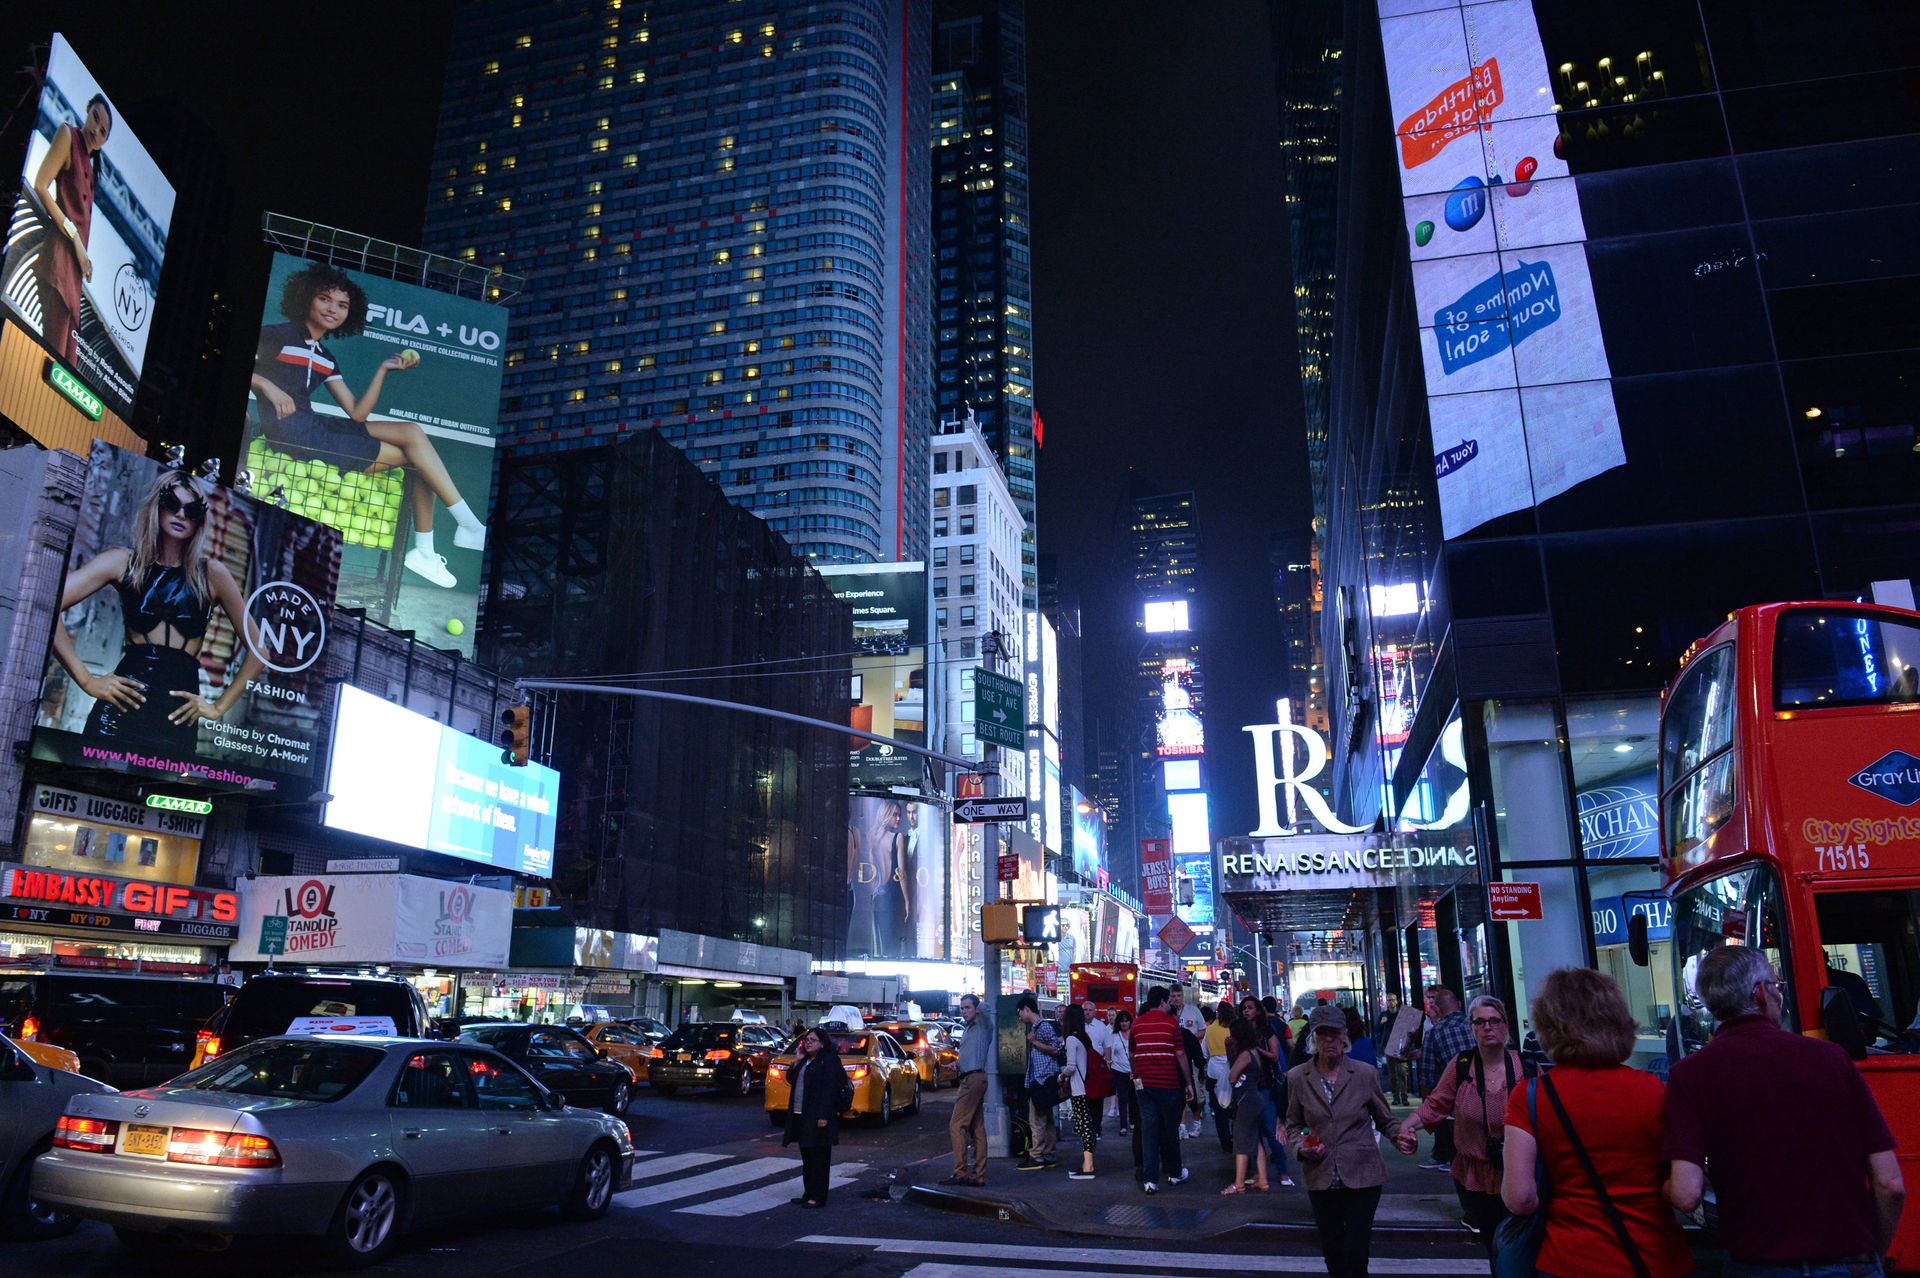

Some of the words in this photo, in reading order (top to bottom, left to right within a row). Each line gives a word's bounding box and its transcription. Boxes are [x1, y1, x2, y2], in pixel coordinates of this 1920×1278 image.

[124, 270, 143, 294] MADE
[129, 283, 137, 295] IN
[118, 286, 142, 324] NY
[110, 325, 135, 353] FASHION
[366, 303, 430, 335] FILA
[459, 324, 500, 350] UO
[363, 330, 400, 345] INTRODUCING
[409, 341, 437, 353] EXCLUSIVE
[438, 347, 470, 361] COLLECTION
[470, 354, 486, 364] FROM
[486, 358, 498, 367] FILA
[56, 370, 99, 415] LAMAR
[389, 408, 419, 421] AVAILABLE
[419, 414, 433, 423] ONLY
[433, 416, 440, 425] AT
[441, 419, 459, 429] URBAN
[460, 422, 490, 436] OUTFITTERS
[265, 590, 312, 616] MADE
[845, 589, 884, 599] Experience
[279, 607, 295, 620] IN
[852, 607, 869, 615] imes
[870, 606, 896, 616] Square.
[258, 618, 316, 660] NY
[1856, 596, 1878, 693] ONEY
[245, 680, 305, 703] FASHION
[977, 672, 1022, 697] SOUTHBOUND
[982, 688, 996, 703] USE
[998, 692, 1003, 705] 7
[1004, 696, 1018, 710] AVE
[204, 719, 249, 741] Clothing
[252, 729, 265, 743] by
[267, 733, 310, 751] Chromat
[979, 722, 997, 736] BEST
[1000, 728, 1021, 745] ROUTE
[213, 736, 253, 754] Glasses
[255, 744, 269, 758] by
[270, 748, 309, 765] A-Morir
[1157, 745, 1204, 756] TOSHIBA
[1858, 771, 1904, 787] Gray
[39, 790, 78, 813] GIFTS
[87, 798, 145, 826] LUGGAGE
[158, 811, 202, 836] T-SHIRT
[152, 796, 206, 813] LAMAR
[962, 805, 985, 816] ONE
[997, 804, 1021, 814] WAY
[1803, 818, 1849, 846] City
[1141, 859, 1170, 877] JERSEY
[1223, 849, 1395, 875] RENAISSANCE
[1814, 844, 1870, 871] 71515
[858, 863, 877, 884] D
[971, 833, 982, 932] PALACE
[1146, 874, 1168, 890] BOYS
[11, 868, 116, 907] EMBASSY
[123, 881, 238, 921] GIFTS
[285, 880, 336, 919] LOL
[1490, 886, 1500, 894] NO
[1501, 886, 1533, 894] STANDING
[1492, 895, 1519, 904] Anytime
[12, 907, 19, 918] I
[29, 910, 50, 921] NY
[180, 923, 230, 937] LUGGAGE
[288, 918, 338, 932] TANDUP
[435, 937, 473, 956] COMED
